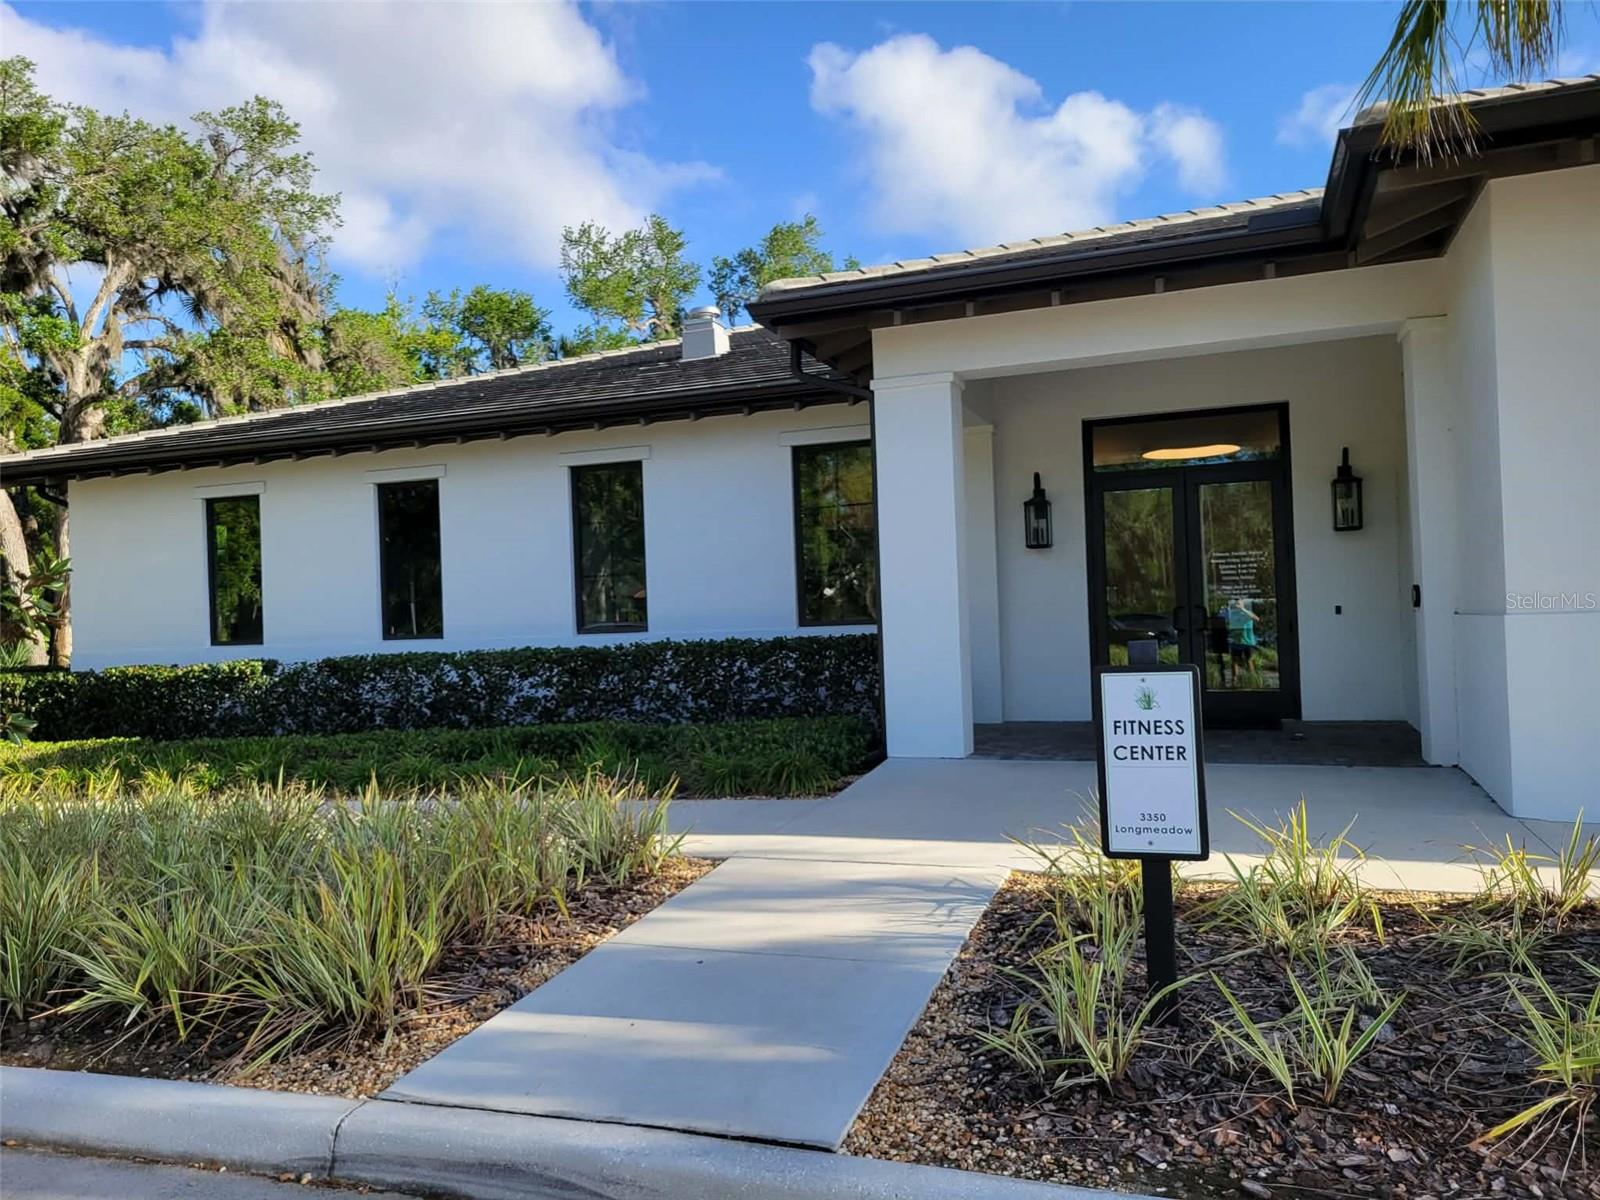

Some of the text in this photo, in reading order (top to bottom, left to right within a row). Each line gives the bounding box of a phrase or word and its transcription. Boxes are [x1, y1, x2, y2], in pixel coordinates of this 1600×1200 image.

[1113, 719, 1185, 736] FITNESS
[1113, 745, 1187, 761] CENTER
[1139, 812, 1166, 822] 3350
[1115, 825, 1193, 836] Longmeadow
